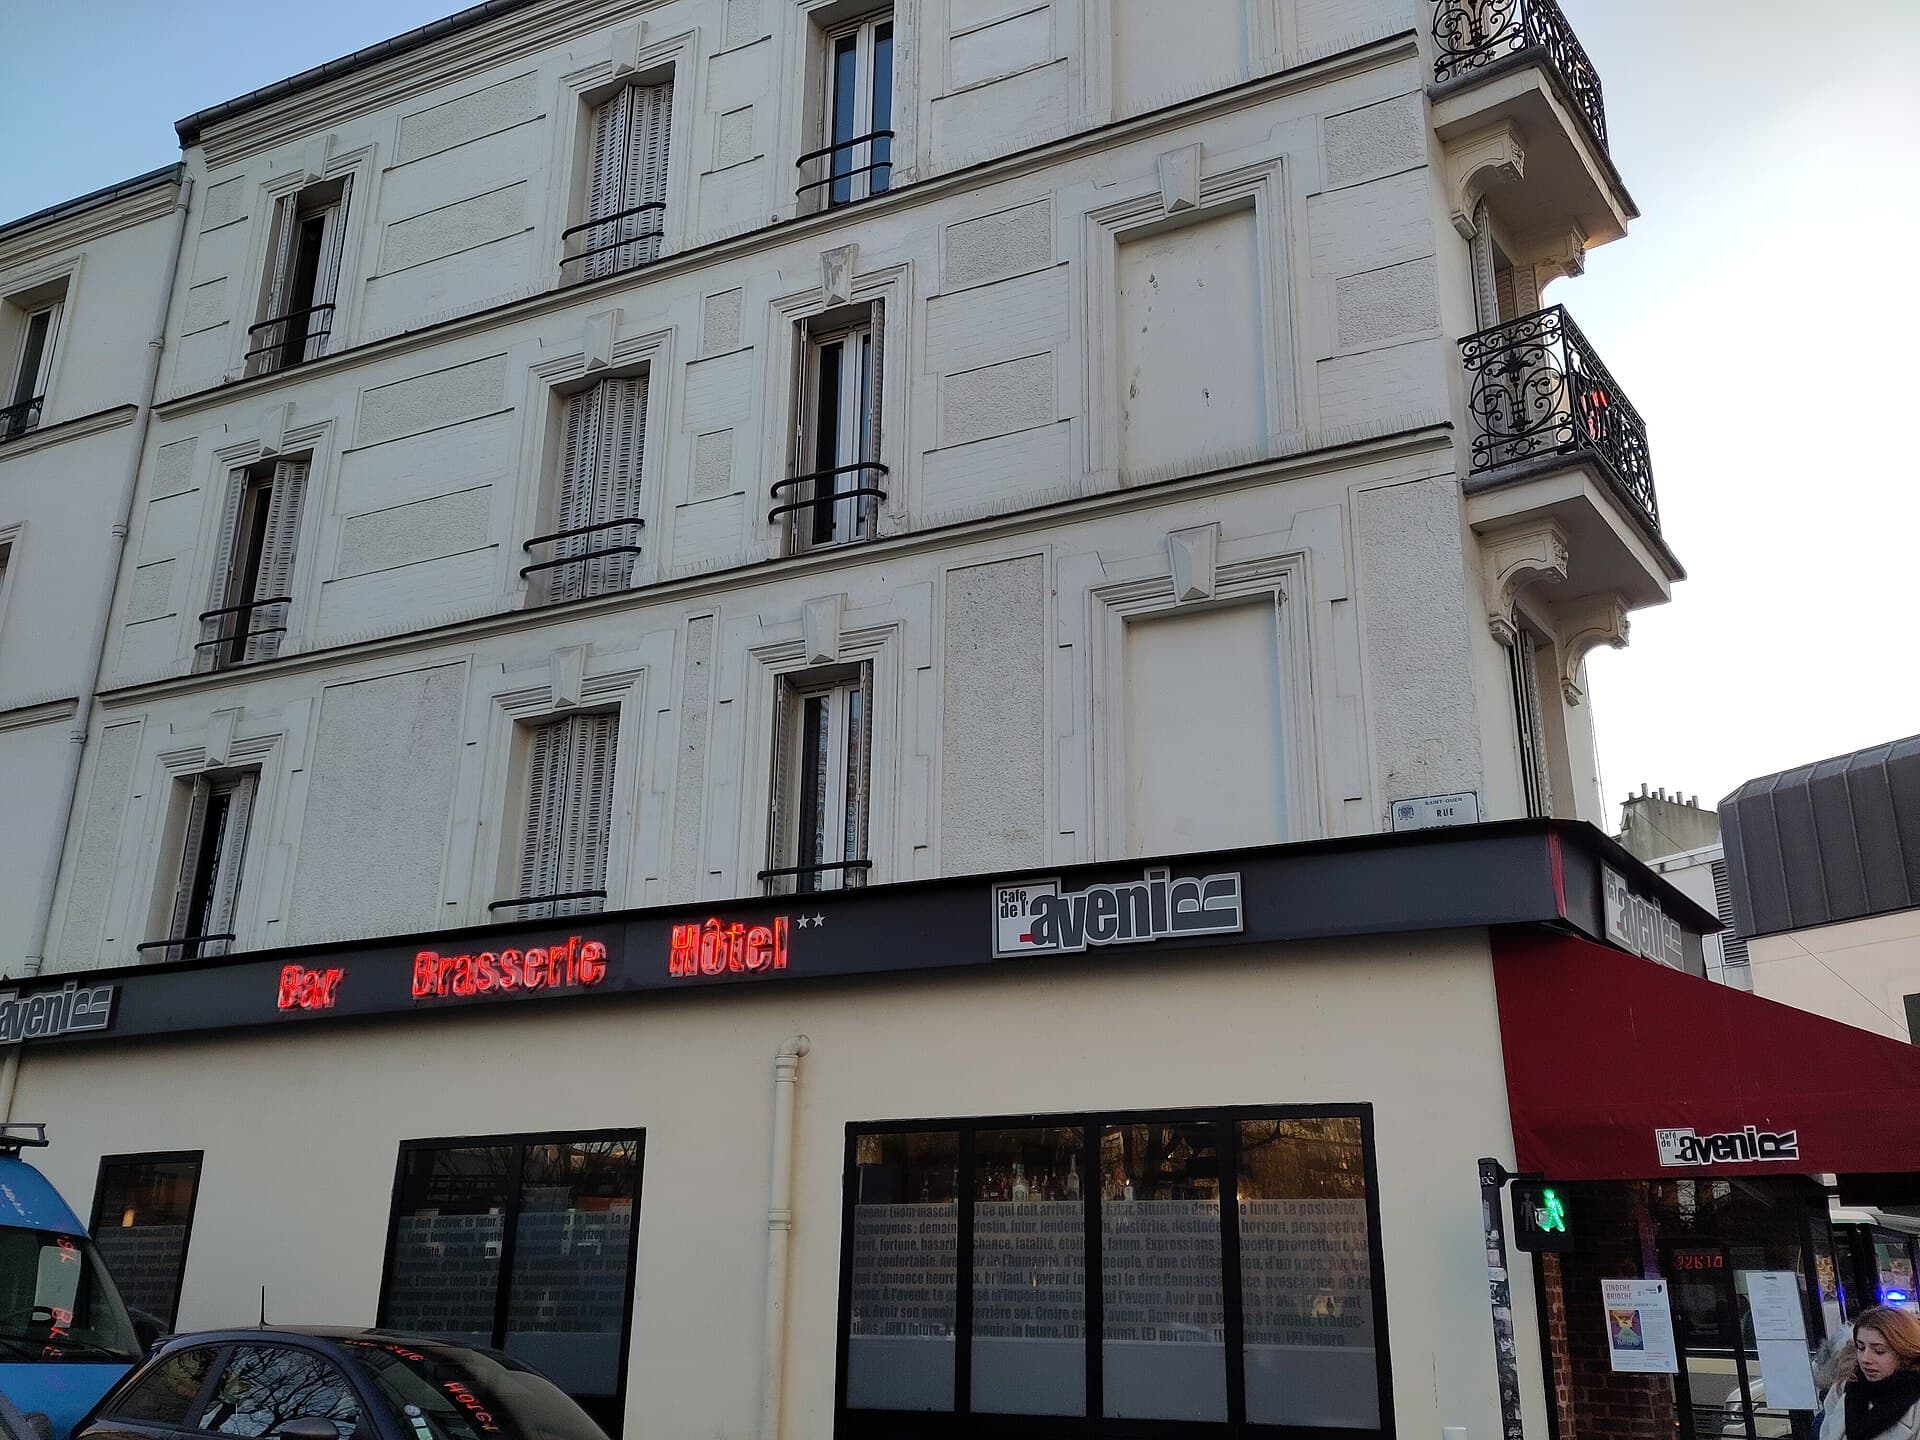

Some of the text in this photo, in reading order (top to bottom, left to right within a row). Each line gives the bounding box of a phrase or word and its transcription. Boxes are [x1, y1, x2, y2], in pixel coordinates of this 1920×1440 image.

[1437, 808, 1455, 818] RUE
[1001, 902, 1018, 919] de
[277, 915, 789, 1011] Bar Brasserie Hôtel
[1606, 1292, 1632, 1300] BRIOCHE
